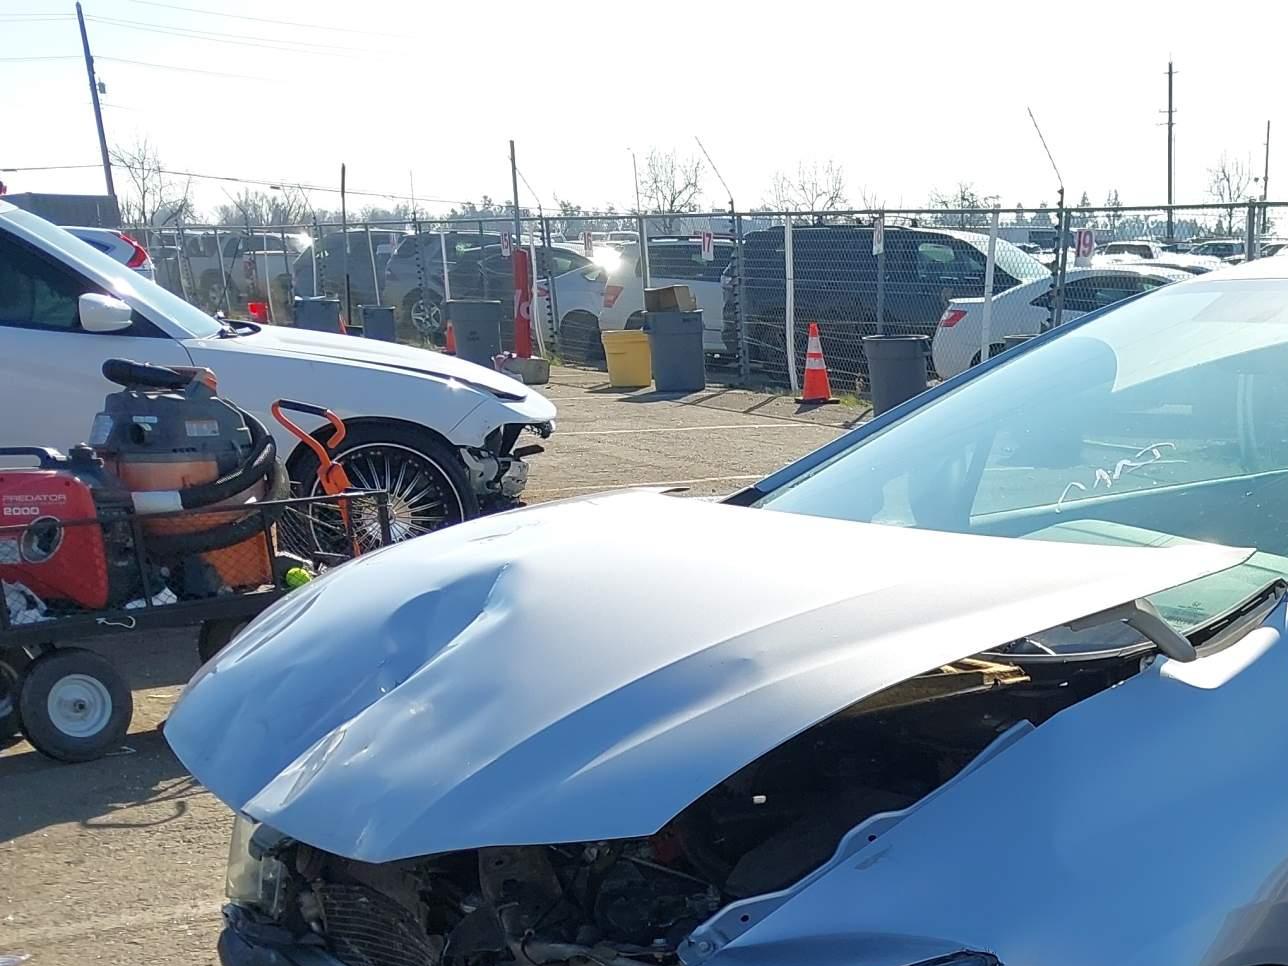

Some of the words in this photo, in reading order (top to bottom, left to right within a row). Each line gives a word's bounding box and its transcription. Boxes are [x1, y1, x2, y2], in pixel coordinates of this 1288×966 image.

[702, 231, 712, 252] 17
[1076, 230, 1093, 257] 19
[2, 494, 67, 502] PREDATOR
[3, 507, 39, 515] 2000
